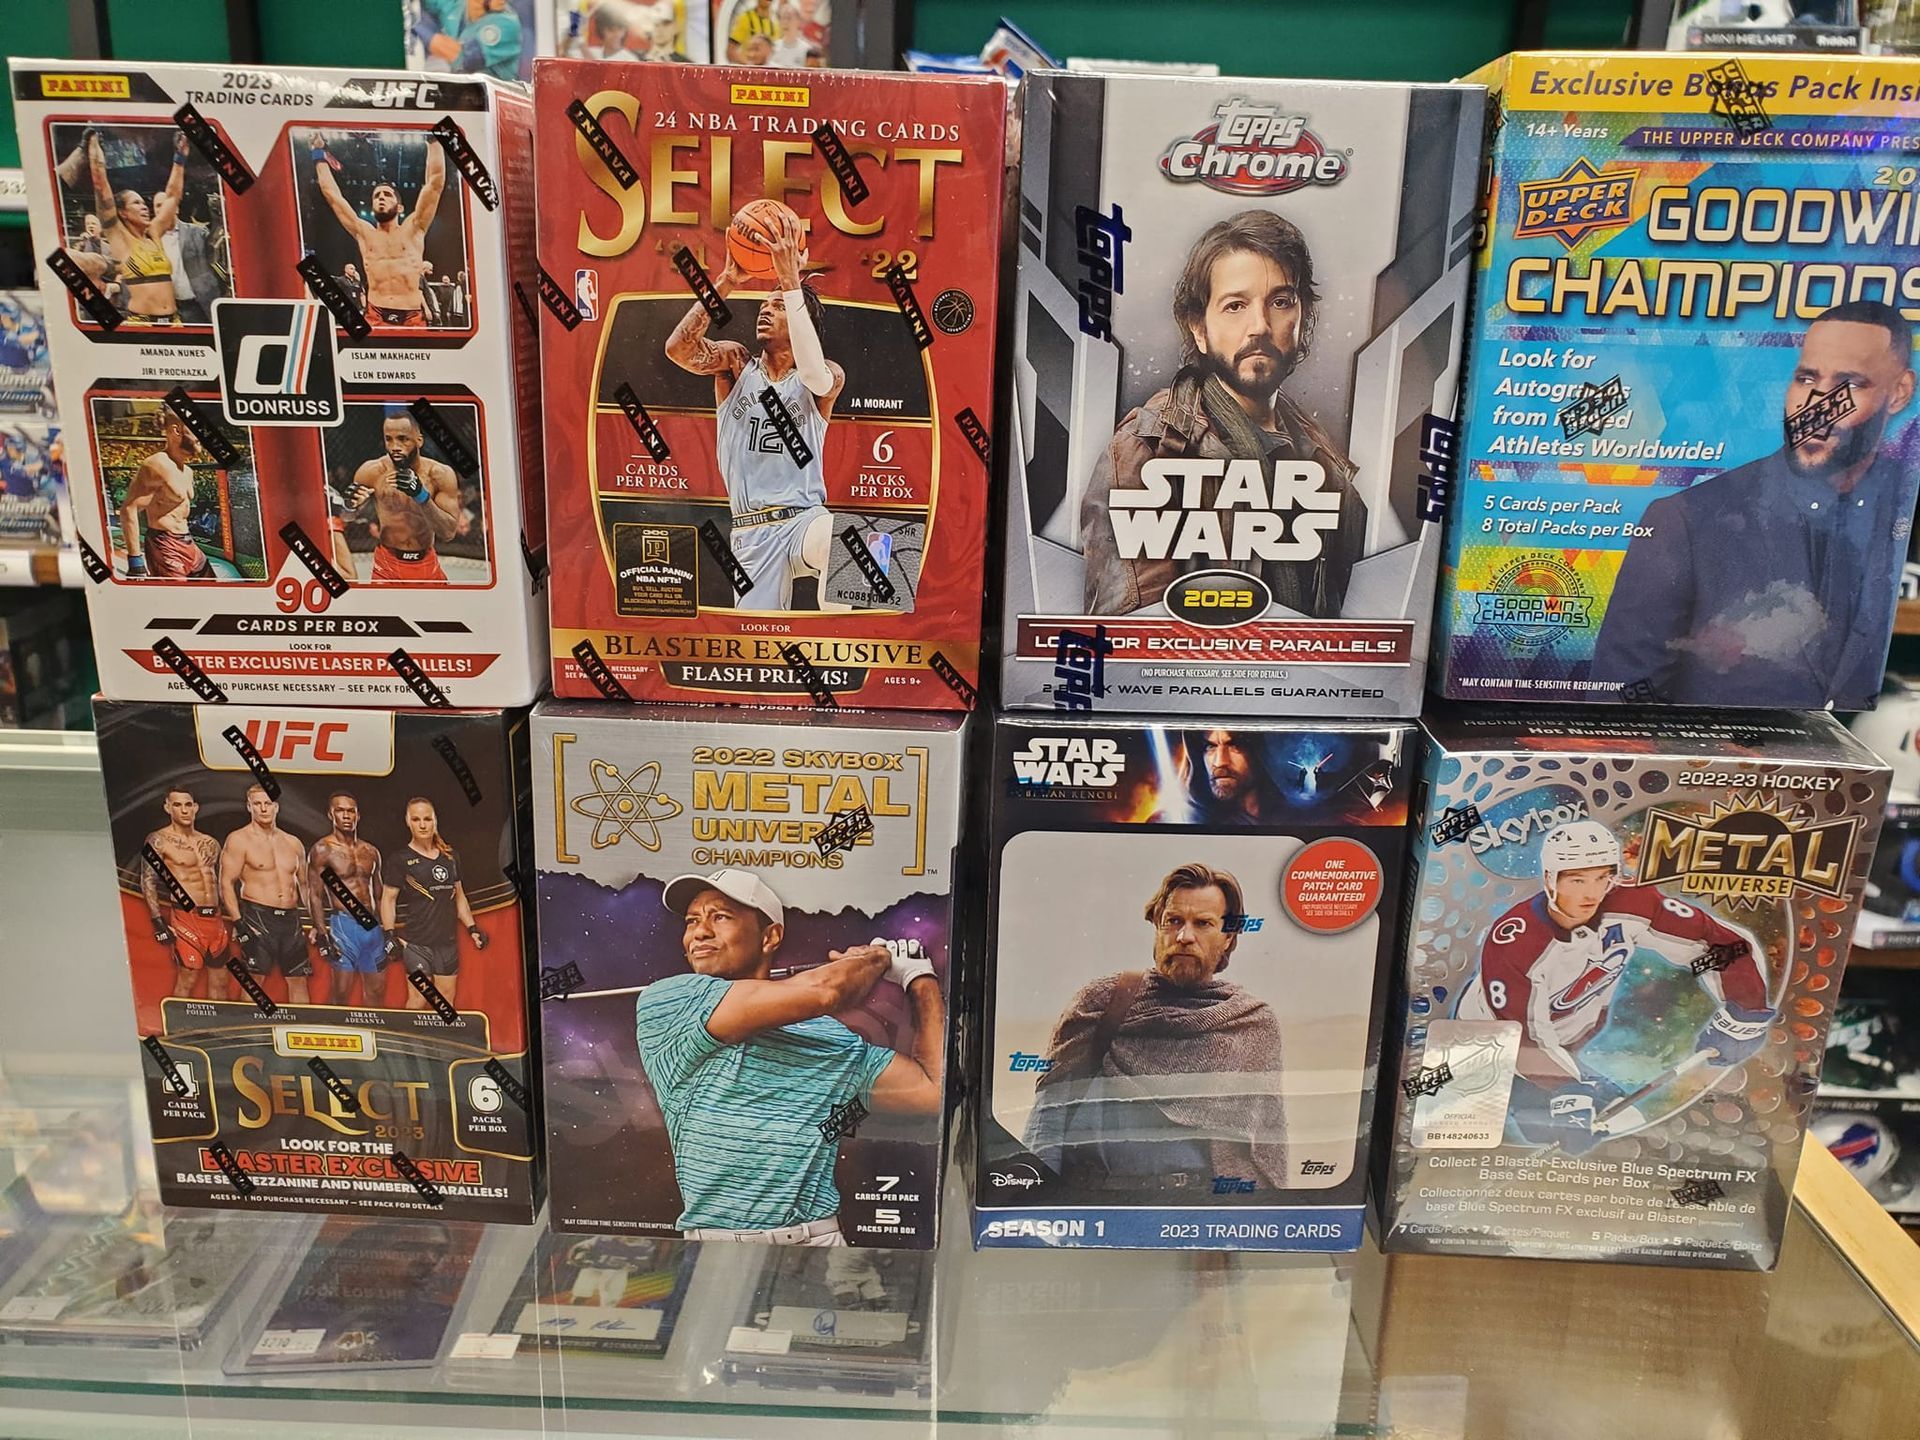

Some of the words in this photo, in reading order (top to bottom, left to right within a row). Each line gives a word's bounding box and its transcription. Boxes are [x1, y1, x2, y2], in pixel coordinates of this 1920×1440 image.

[46, 79, 125, 94] PANINI
[222, 73, 273, 91] 2023
[1529, 70, 1674, 97] Exclusive
[1788, 75, 1862, 101] Pack
[186, 91, 256, 105] TRADING
[259, 93, 315, 108] CARDS
[734, 88, 806, 103] PANINI
[654, 112, 678, 130] 24
[688, 114, 739, 135] NBA
[876, 121, 961, 142] CARDS
[1563, 124, 1609, 140] Years
[1643, 130, 1673, 144] THE
[1680, 132, 1734, 146] UPPER
[1790, 134, 1874, 149] COMPANY
[1526, 181, 1629, 209] UPPER
[140, 349, 176, 359] AMANDA
[178, 350, 207, 359] NUNES
[351, 353, 378, 362] ISLAM
[380, 353, 432, 362] MAKHACHEV
[1499, 347, 1558, 369] Look
[1562, 349, 1597, 373] for
[142, 368, 158, 378] JIRI
[160, 369, 209, 379] PROCHAZKA
[353, 371, 375, 381] LEON
[377, 372, 418, 381] EDWARDS
[235, 399, 332, 416] DONRUSS
[850, 398, 862, 409] JA
[864, 399, 904, 410] MORANT
[1492, 410, 1547, 431] from
[872, 430, 895, 464] 6
[1487, 434, 1586, 456] Athletes
[1590, 438, 1725, 464] Worldwide!
[625, 463, 679, 476] CARDS
[616, 476, 644, 489] PER
[649, 478, 689, 491] PACK
[859, 473, 906, 487] PACKS
[1108, 457, 1342, 511] STAR
[851, 485, 879, 498] PER
[883, 487, 914, 500] BOX
[1483, 495, 1494, 509] 5
[1499, 496, 1547, 511] Cards
[1549, 501, 1577, 517] per
[1581, 500, 1622, 514] Pack
[1108, 509, 1340, 562] WARS
[1481, 518, 1492, 533] 8
[1497, 518, 1536, 534] Total
[1540, 522, 1586, 536] Packs
[1590, 525, 1618, 542] per
[1621, 525, 1654, 538] Box
[1530, 552, 1556, 561] DECK
[636, 575, 656, 584] NBA
[1184, 590, 1254, 608] 2023
[1494, 598, 1575, 613] GOODWIN
[1481, 609, 1585, 624] CHAMPIONS
[236, 619, 298, 633] CARDS
[303, 620, 337, 633] PER
[341, 621, 380, 634] BOX
[741, 623, 769, 633] LOOK
[770, 625, 791, 634] FOR
[289, 643, 312, 653] LOOK
[314, 644, 333, 653] FOR
[604, 635, 748, 661] BLASTER
[753, 640, 922, 669] EXCLUSIVE
[1147, 638, 1263, 652] EXCLUSIVE
[1269, 639, 1397, 654] PARALLELS!
[229, 656, 319, 671] EXCLUSIVE
[322, 658, 373, 672] LASER
[611, 667, 648, 675] NECESSARY
[682, 665, 753, 682] FLASH
[1154, 668, 1185, 678] PURCHASE
[232, 683, 281, 693] PURCHASE
[283, 684, 336, 695] NECESSARY
[348, 685, 365, 695] SEE
[368, 686, 392, 696] PACK
[394, 686, 411, 696] FOR
[884, 677, 907, 688] AGES
[909, 679, 922, 689] 9+
[1481, 679, 1512, 689] CONTAIN
[1514, 680, 1574, 691] TIME-SENSITIVE
[1117, 685, 1163, 696] WAVE
[1169, 686, 1266, 697] PARALLELS
[1270, 687, 1384, 699] GUARANTEED
[1560, 727, 1650, 738] Numbers
[1012, 737, 1126, 763] STAR
[692, 746, 775, 768] 2022
[782, 750, 905, 772] SKYBOX
[1012, 761, 1125, 788] WARS
[1678, 771, 1758, 792] 2022-23
[1761, 774, 1843, 797] HOCKEY
[692, 769, 911, 817] METAL
[1070, 791, 1119, 800] KENOBI
[691, 848, 846, 869] CHAMPIONS
[1645, 817, 1840, 888] METAL
[1325, 859, 1346, 870] ONE
[1291, 871, 1377, 881] COMMEMORATIVE
[1302, 881, 1334, 891] PATCH
[1336, 881, 1364, 891] CARD
[1686, 874, 1791, 895] UNIVERSE
[1298, 892, 1367, 903] GUARANTEED!
[345, 1018, 386, 1026] ADESANYA
[350, 1011, 378, 1019] ISRAEL
[167, 1102, 200, 1110] CARDS
[163, 1110, 183, 1118] PER
[183, 1111, 207, 1119] PACK
[472, 1115, 503, 1125] PACKS
[1443, 1112, 1476, 1120] OFFICIAL
[468, 1124, 488, 1133] PER
[489, 1124, 508, 1133] BOX
[280, 1138, 325, 1151] LOOK
[329, 1139, 360, 1154] FOR
[361, 1142, 395, 1155] THE
[1429, 1155, 1478, 1169] Collect
[1482, 1156, 1491, 1168] 2
[1621, 1161, 1654, 1177] Blue
[1657, 1165, 1732, 1182] Spectrum
[1736, 1170, 1758, 1184] FX
[177, 1172, 213, 1184] BASE
[1479, 1168, 1514, 1182] Base
[1517, 1170, 1543, 1183] Set
[1546, 1170, 1591, 1185] Cards
[1623, 1176, 1651, 1191] Box
[210, 1193, 231, 1201] AGES
[264, 1196, 304, 1204] PURCHASE
[305, 1198, 349, 1206] NECESSARY
[374, 1200, 394, 1208] PACK
[854, 1192, 881, 1201] CARDS
[882, 1193, 898, 1202] PER
[899, 1194, 920, 1203] PACK
[1488, 1202, 1552, 1217] Spectrum
[1627, 1211, 1645, 1222] au
[639, 1222, 675, 1230] REDEMPTIONS
[857, 1224, 883, 1234] PACKS
[884, 1225, 899, 1234] PER
[900, 1226, 917, 1235] BOX
[985, 1219, 1085, 1239] SEASON
[1160, 1223, 1200, 1238] 2023
[1205, 1223, 1280, 1239] TRADING
[1284, 1224, 1343, 1239] CARDS
[1591, 1231, 1601, 1241] 5
[1672, 1235, 1683, 1246] 5
